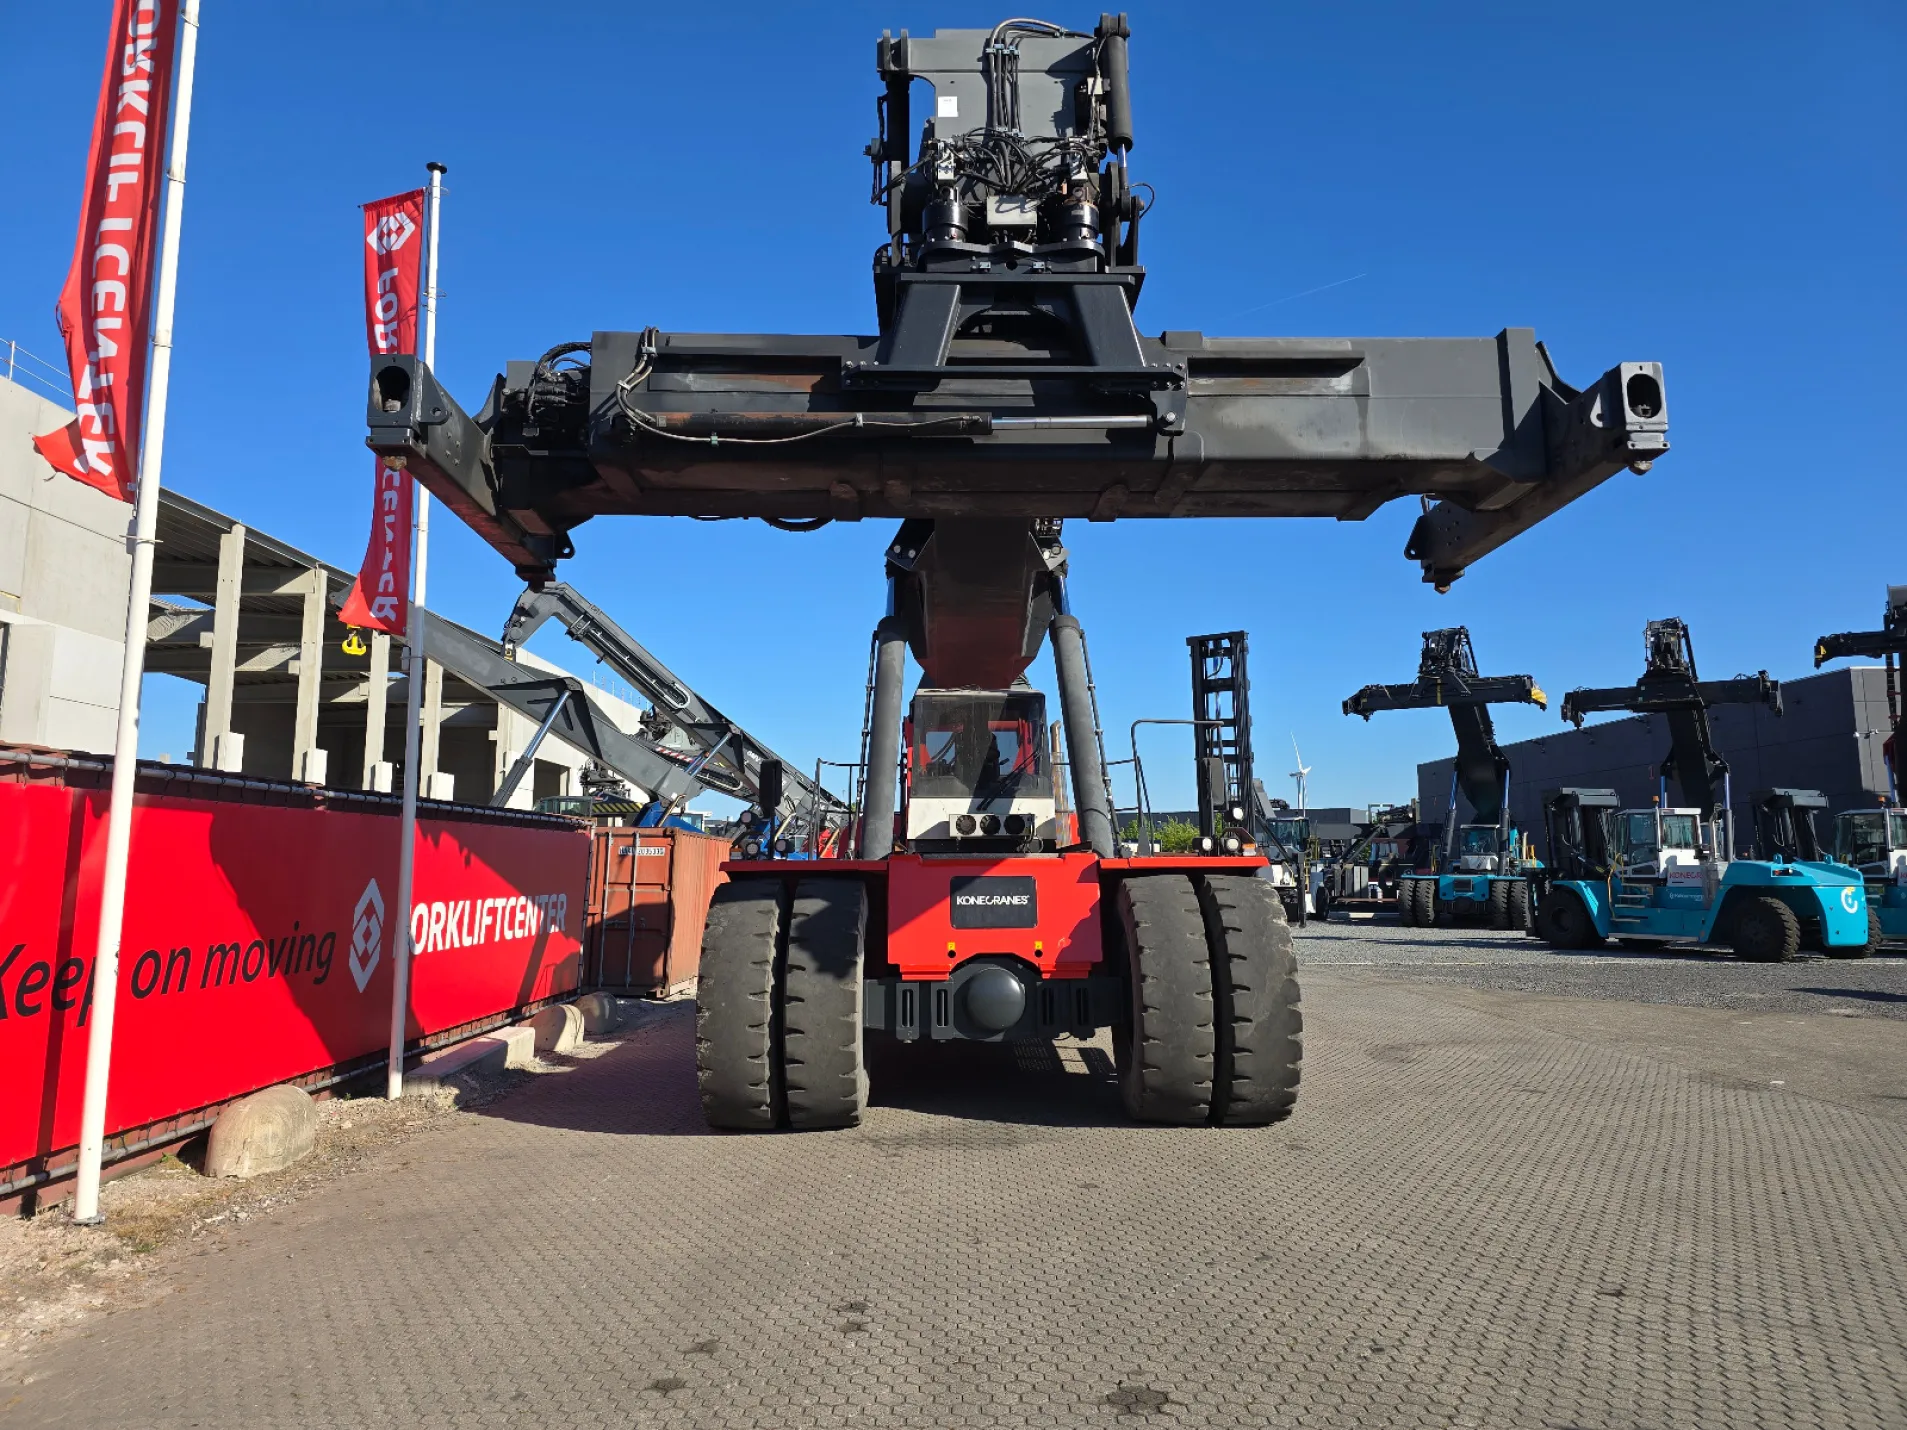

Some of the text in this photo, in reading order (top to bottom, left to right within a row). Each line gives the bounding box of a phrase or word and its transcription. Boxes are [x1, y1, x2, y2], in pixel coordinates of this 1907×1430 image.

[393, 894, 567, 955] ORKLIFTCENTER
[956, 895, 1028, 906] KONECRANES
[130, 945, 191, 999] on
[200, 921, 336, 985] moving
